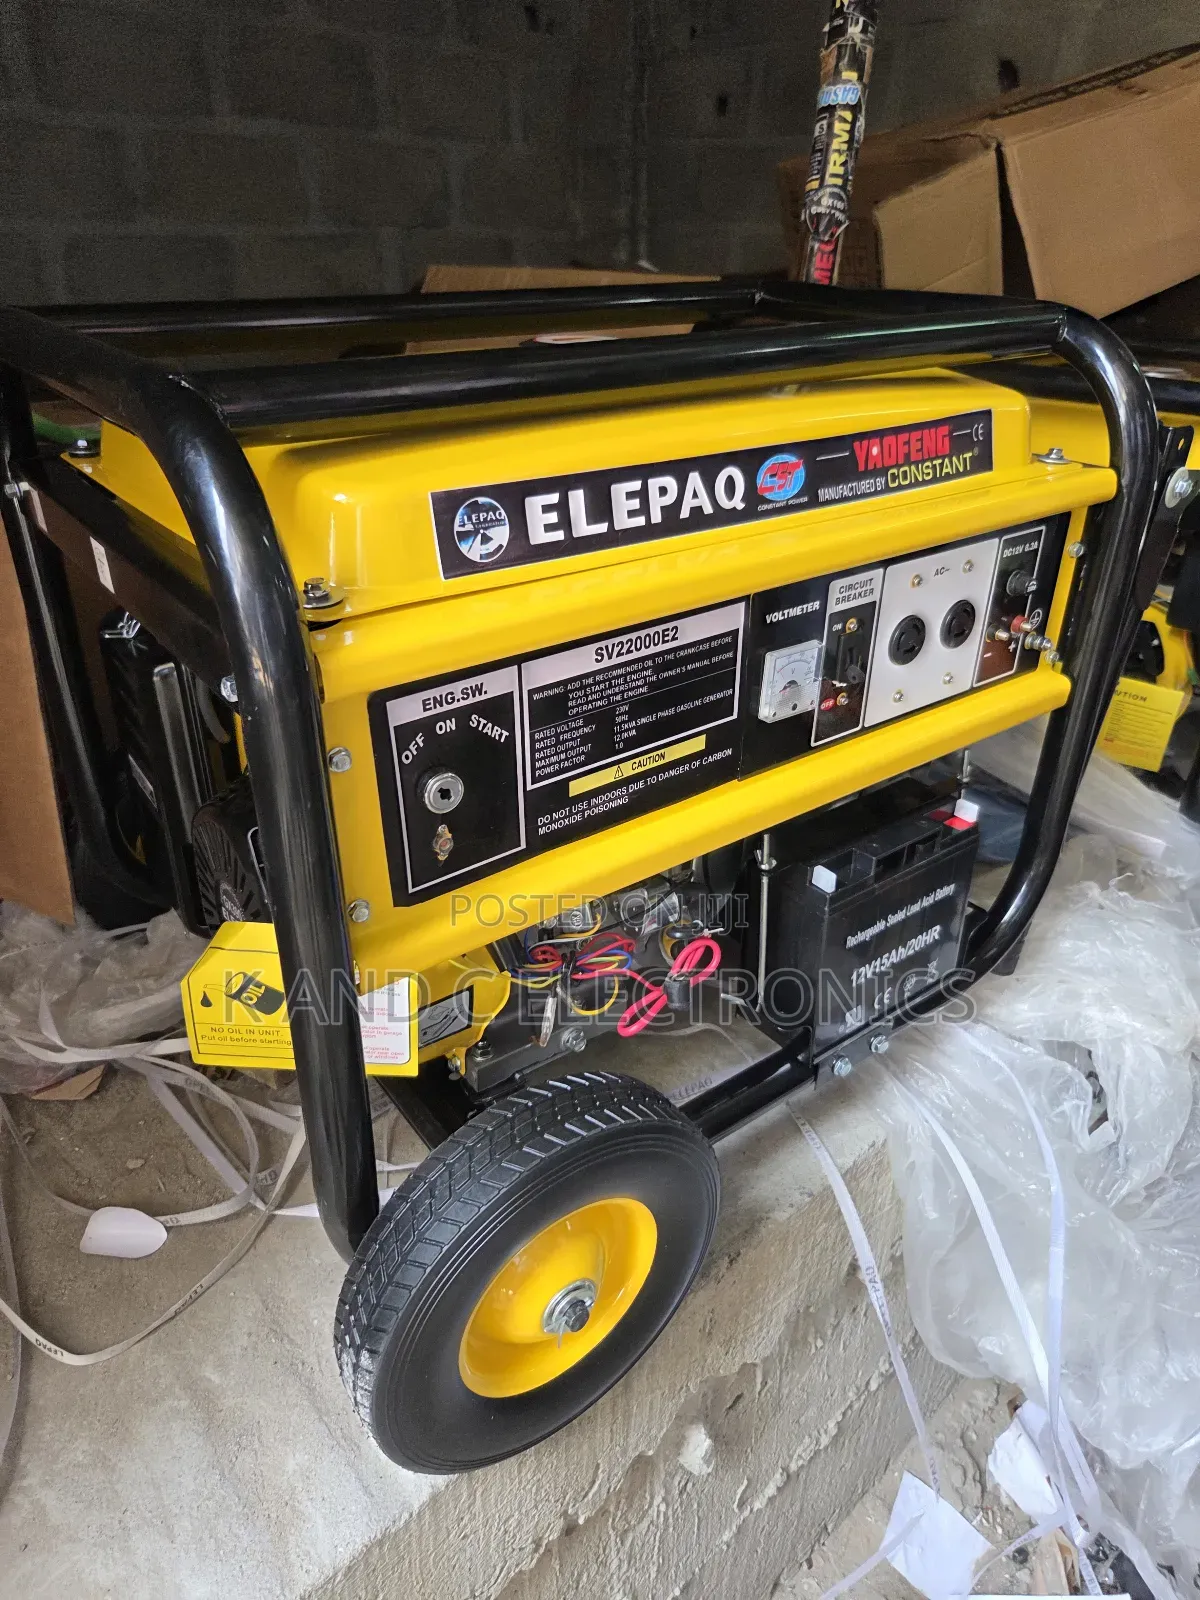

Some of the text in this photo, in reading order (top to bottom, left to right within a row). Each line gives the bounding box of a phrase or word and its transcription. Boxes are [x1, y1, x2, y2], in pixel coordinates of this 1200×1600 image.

[853, 425, 950, 472] YAOFENG
[818, 452, 973, 503] MANUFACTURED BY CONSTANT
[458, 510, 505, 525] ELEPAQ
[524, 466, 745, 545] ELEPAQ
[757, 500, 788, 512] CONSTANT
[834, 588, 875, 606] BREAKER
[838, 578, 874, 595] CIRCUIT
[765, 601, 820, 624] VOLTMETER
[832, 623, 842, 632] ON
[594, 625, 679, 664] SV22000E2
[532, 635, 733, 700] WARNING: ADD THE RECOMMENDED OIL TO THE CRANKCASE BEFORE
[568, 651, 734, 707] READ AND UNDERSTAND THE OWNER'S MANUAL BEFORE
[421, 682, 488, 712] ENG.SW.
[568, 669, 655, 699] YOU START THE ENGINE.
[568, 685, 649, 716] OPERATING THE ENGINE
[820, 698, 835, 710] OFF
[435, 718, 457, 735] ON
[469, 714, 509, 743] START
[534, 704, 629, 740] RATED VOLTAGE 230V
[535, 688, 734, 760] RATED OUTPUT 11.5KVA SINGLE PHASE GASOLINE GENERATOR
[535, 714, 629, 750] RATED FREQUENCY 50Hz
[401, 733, 426, 765] OFF
[535, 730, 637, 769] MAXIMUM OUTPUT 12.0KVA
[535, 743, 624, 778] POWER FACTOR 1.0
[631, 751, 666, 771] CAUTION
[537, 748, 733, 826] DO NOT USE INDOORS DUE TO DANGER OF CARBON
[538, 795, 629, 836] MONOXIDE POISONING
[845, 883, 956, 949] Rechargeable Sealed Lead Acid Battery
[850, 925, 942, 987] 12V15Ah/20HR
[240, 985, 266, 1005] OIL
[874, 987, 892, 1010] CE
[260, 1038, 292, 1046] starting
